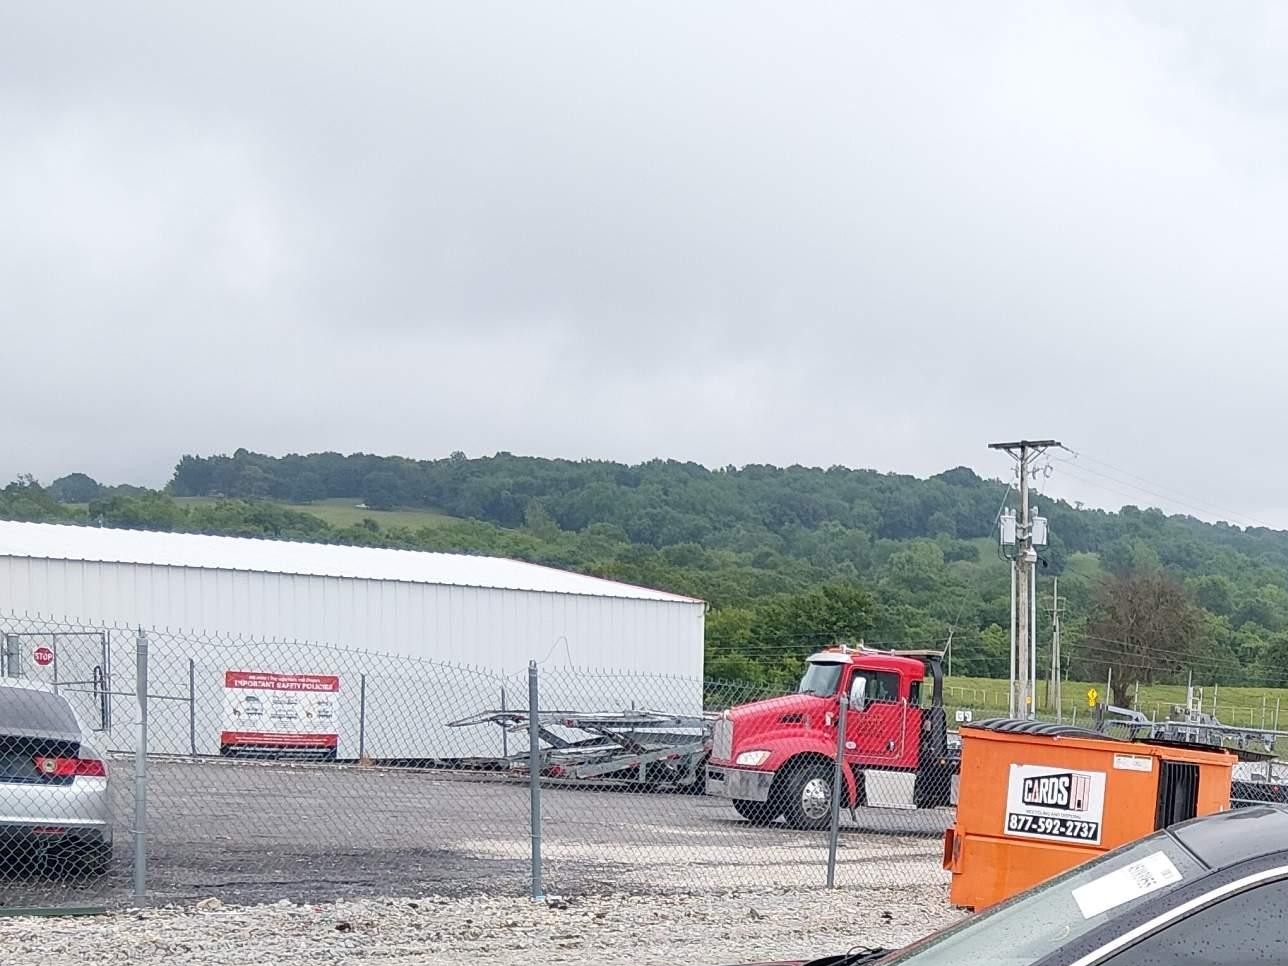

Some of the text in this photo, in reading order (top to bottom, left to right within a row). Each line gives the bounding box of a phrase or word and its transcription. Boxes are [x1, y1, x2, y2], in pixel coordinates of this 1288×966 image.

[35, 652, 53, 661] STOP
[234, 680, 275, 688] IMPORTANT
[276, 682, 301, 690] SAFETY
[1024, 777, 1069, 805] CARDS
[1010, 815, 1096, 838] 877-592-2737
